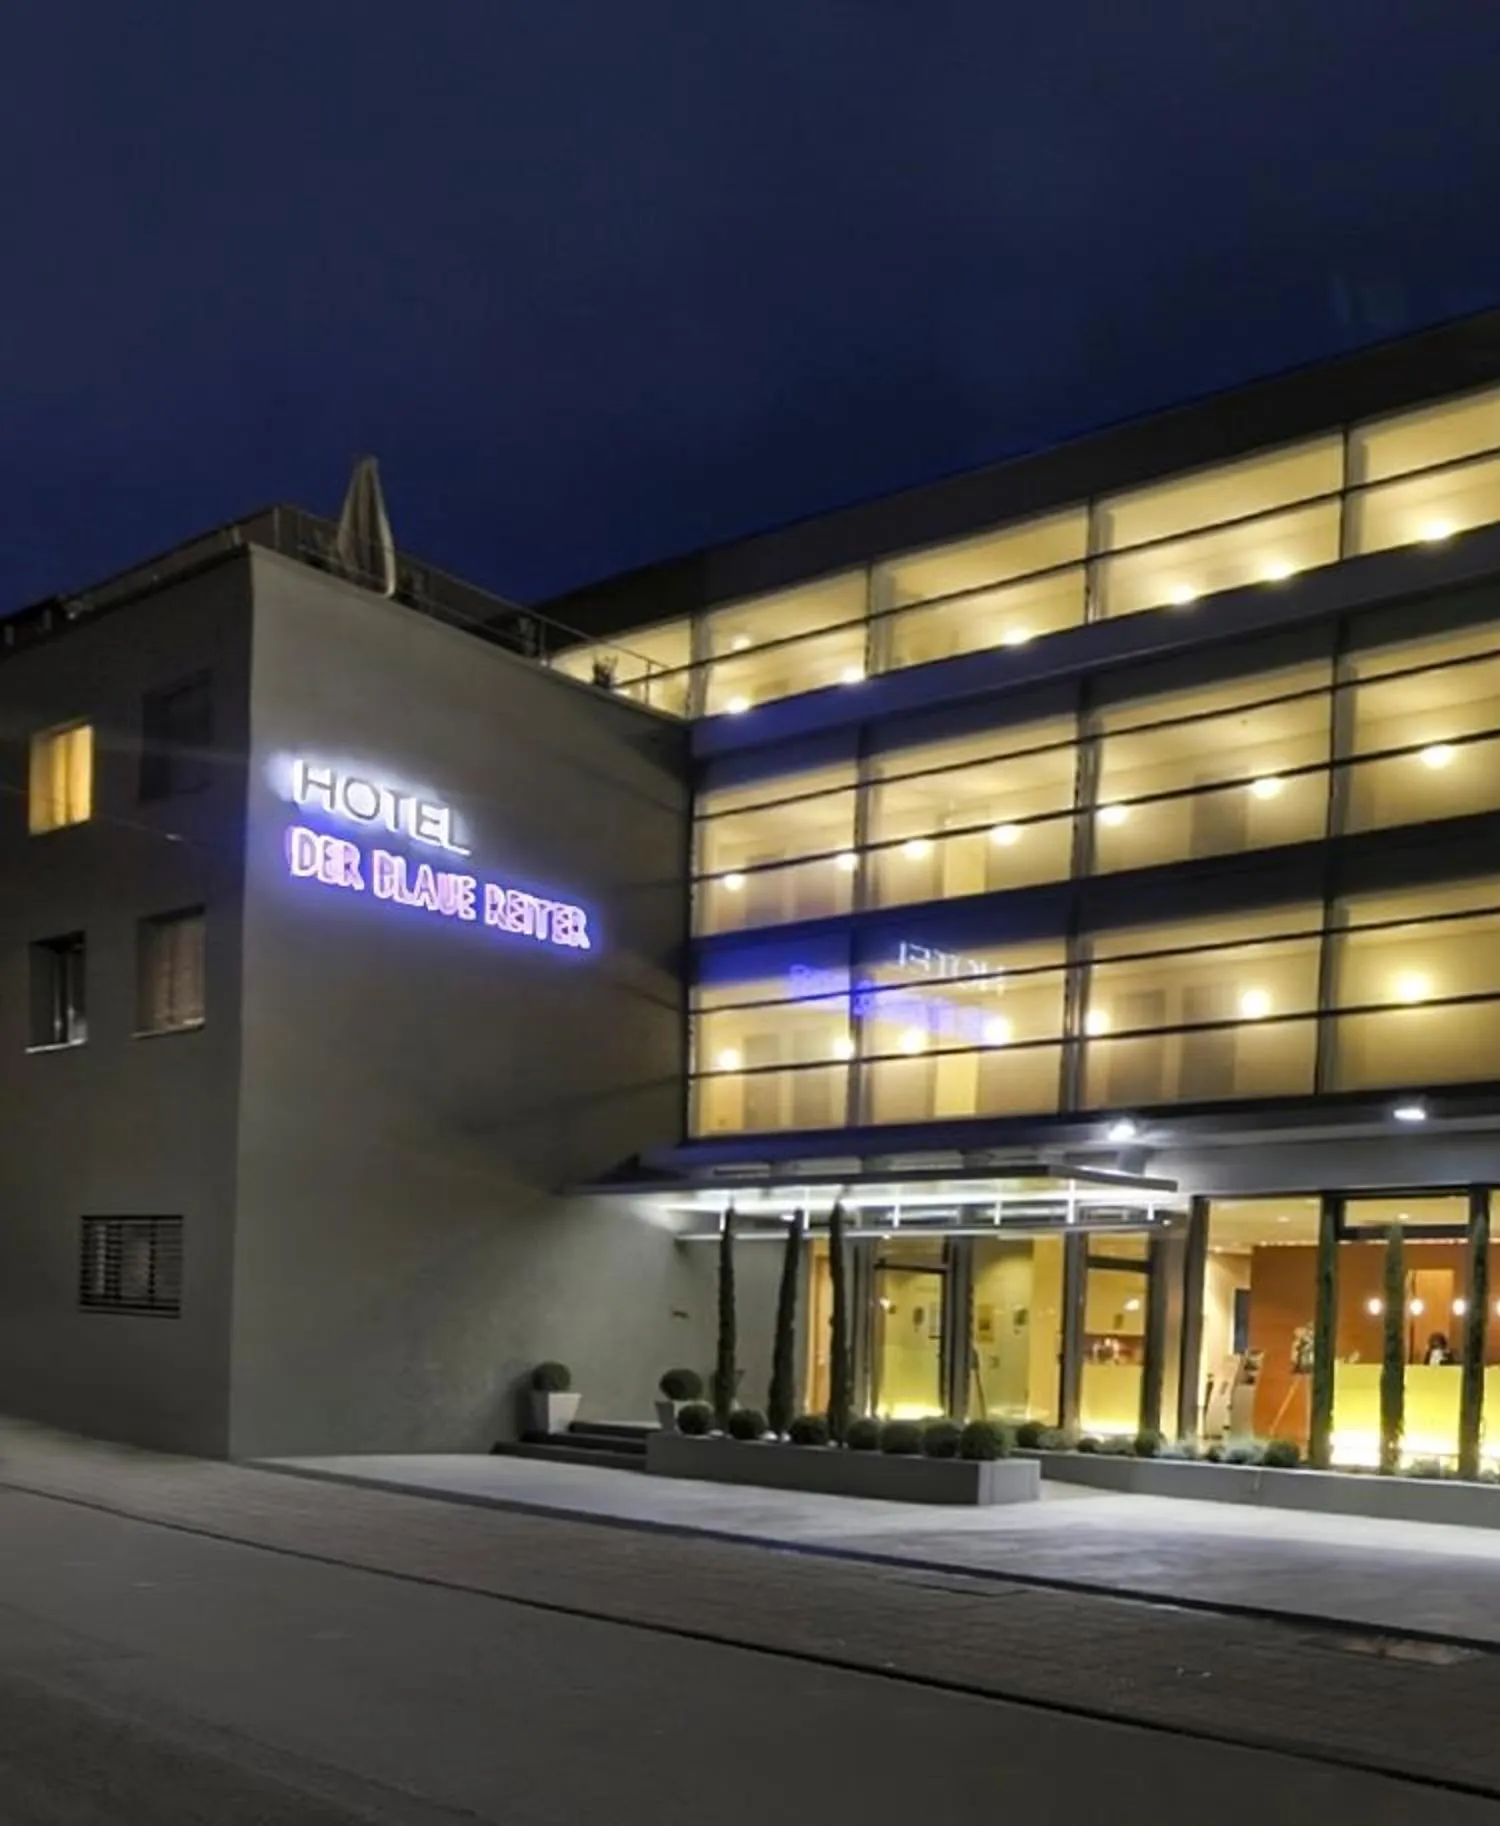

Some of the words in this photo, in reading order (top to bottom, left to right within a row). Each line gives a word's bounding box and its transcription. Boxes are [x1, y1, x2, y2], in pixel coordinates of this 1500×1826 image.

[293, 759, 472, 855] HOTEL
[290, 826, 364, 890] DER
[371, 850, 477, 919] BLAUE
[484, 883, 590, 948] REITER
